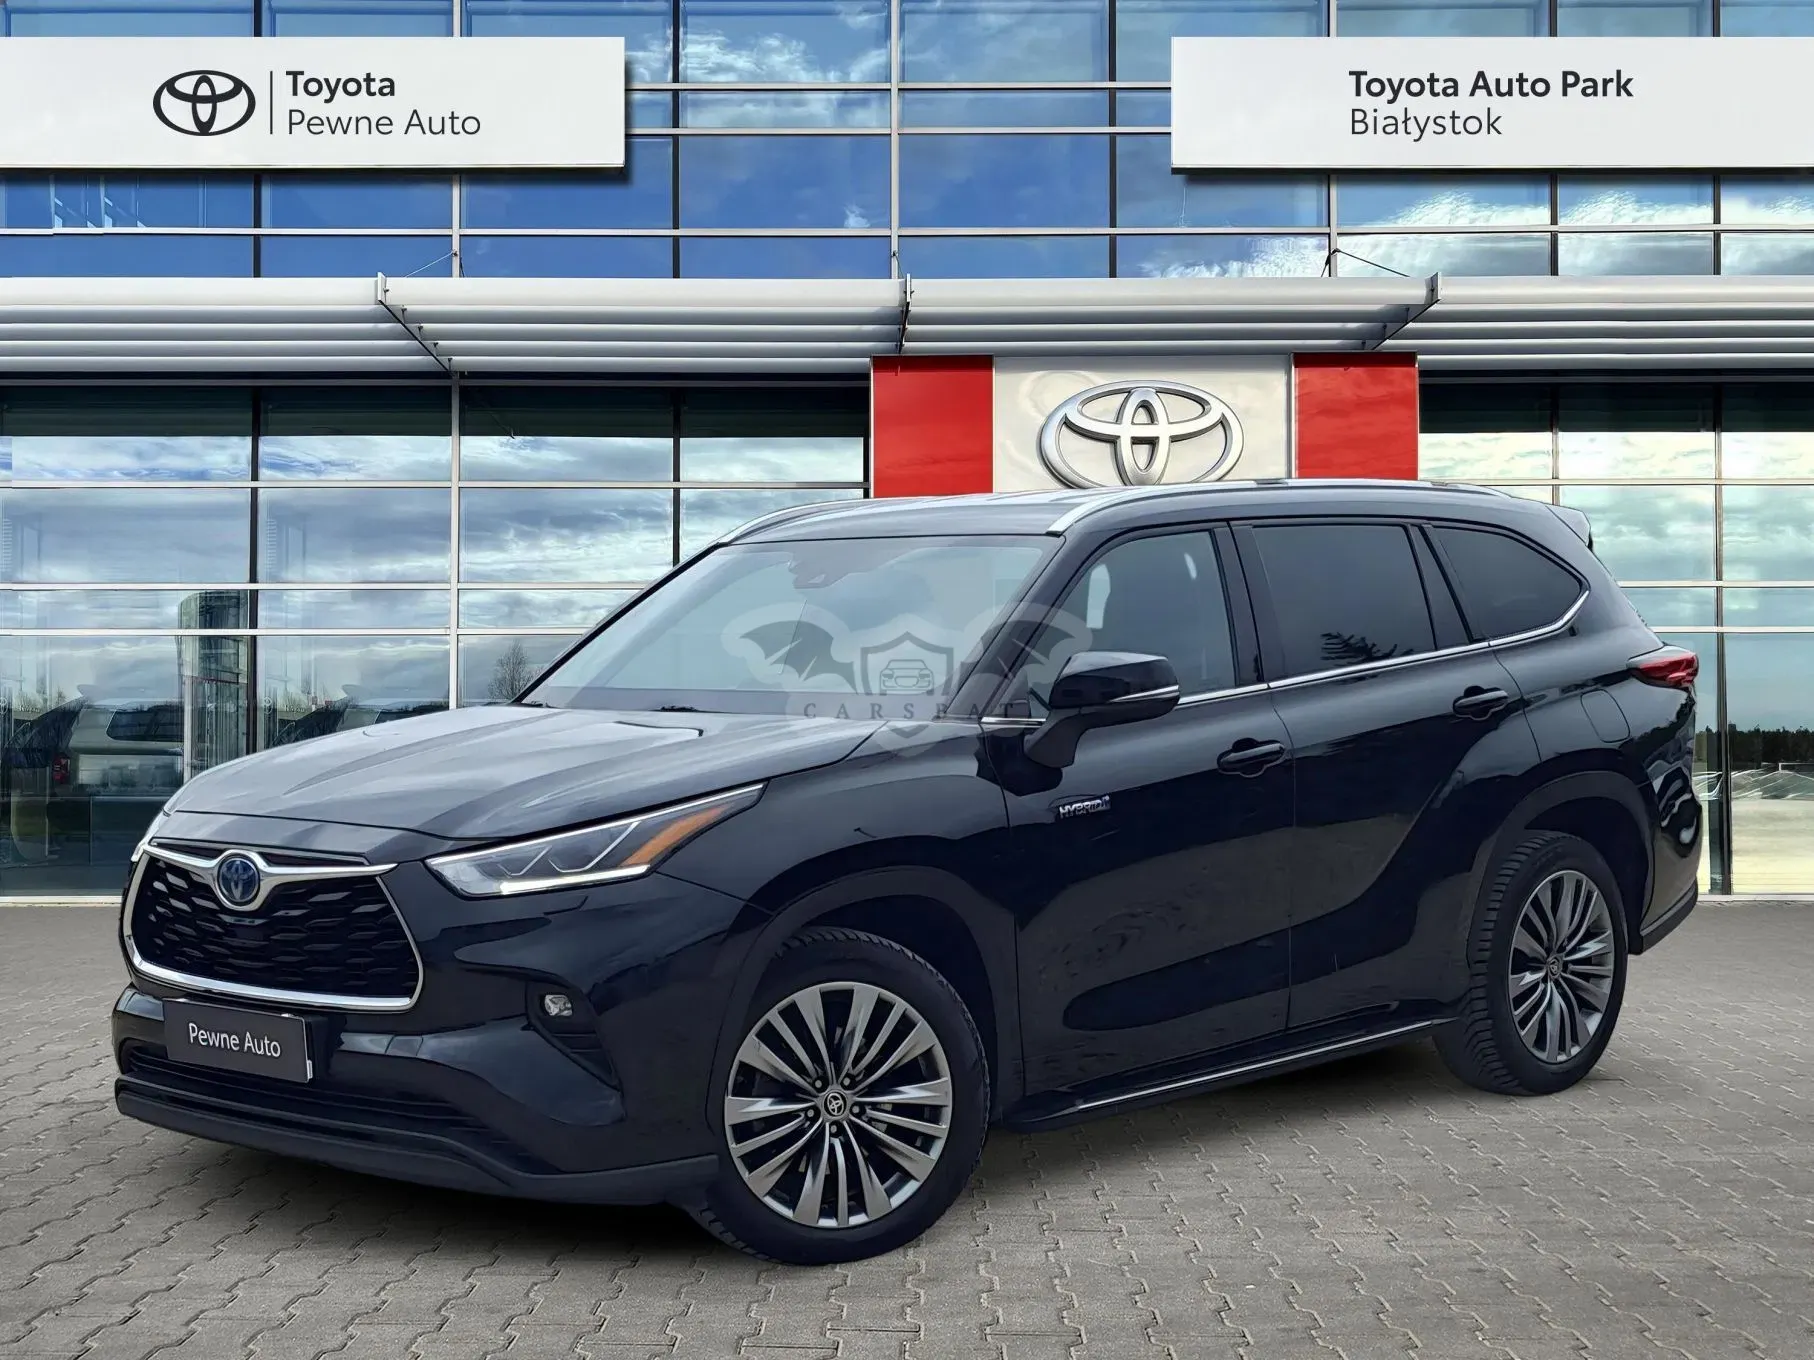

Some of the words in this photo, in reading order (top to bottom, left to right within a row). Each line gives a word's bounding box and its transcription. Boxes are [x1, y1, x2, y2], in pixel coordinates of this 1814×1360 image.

[286, 71, 396, 104] Toyota
[1349, 71, 1459, 104] Toyota
[1469, 71, 1551, 98] Auto
[1562, 69, 1634, 98] Park
[289, 109, 394, 136] Pewne
[404, 109, 481, 136] Auto
[1352, 106, 1503, 143] Białystok
[188, 1022, 240, 1051] Pewne
[243, 1031, 281, 1058] Auto
